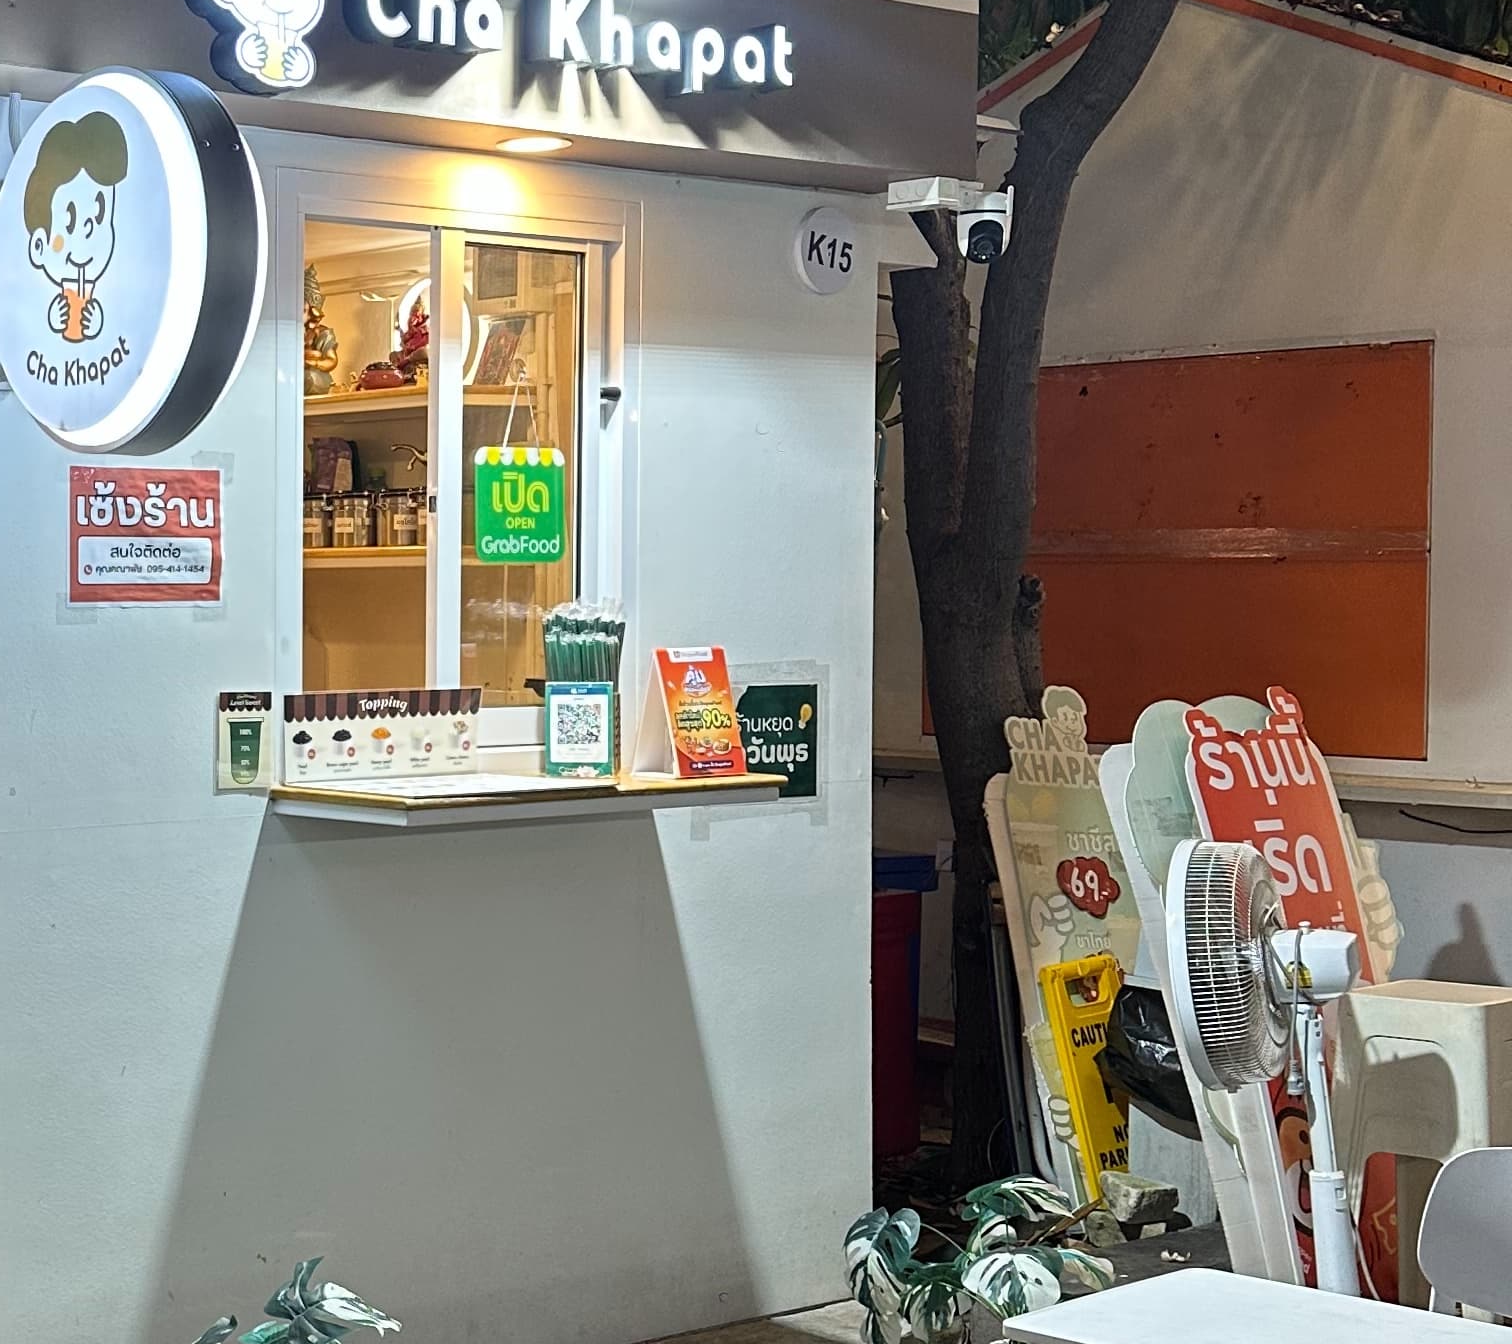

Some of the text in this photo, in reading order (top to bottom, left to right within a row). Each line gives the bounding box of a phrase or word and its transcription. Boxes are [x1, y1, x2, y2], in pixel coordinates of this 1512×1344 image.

[808, 230, 853, 273] K15
[26, 335, 131, 387] Cha Khapat
[76, 481, 216, 528] เซ้งร้าน
[491, 471, 550, 513] เปิด
[505, 517, 536, 529] OPEN
[109, 542, 181, 559] สนใจติดต่อ
[481, 534, 560, 554] GrabFood
[358, 695, 409, 713] Topping
[701, 708, 732, 729] 90%
[1008, 720, 1062, 753] CHA
[1013, 751, 1100, 785] KHAPA
